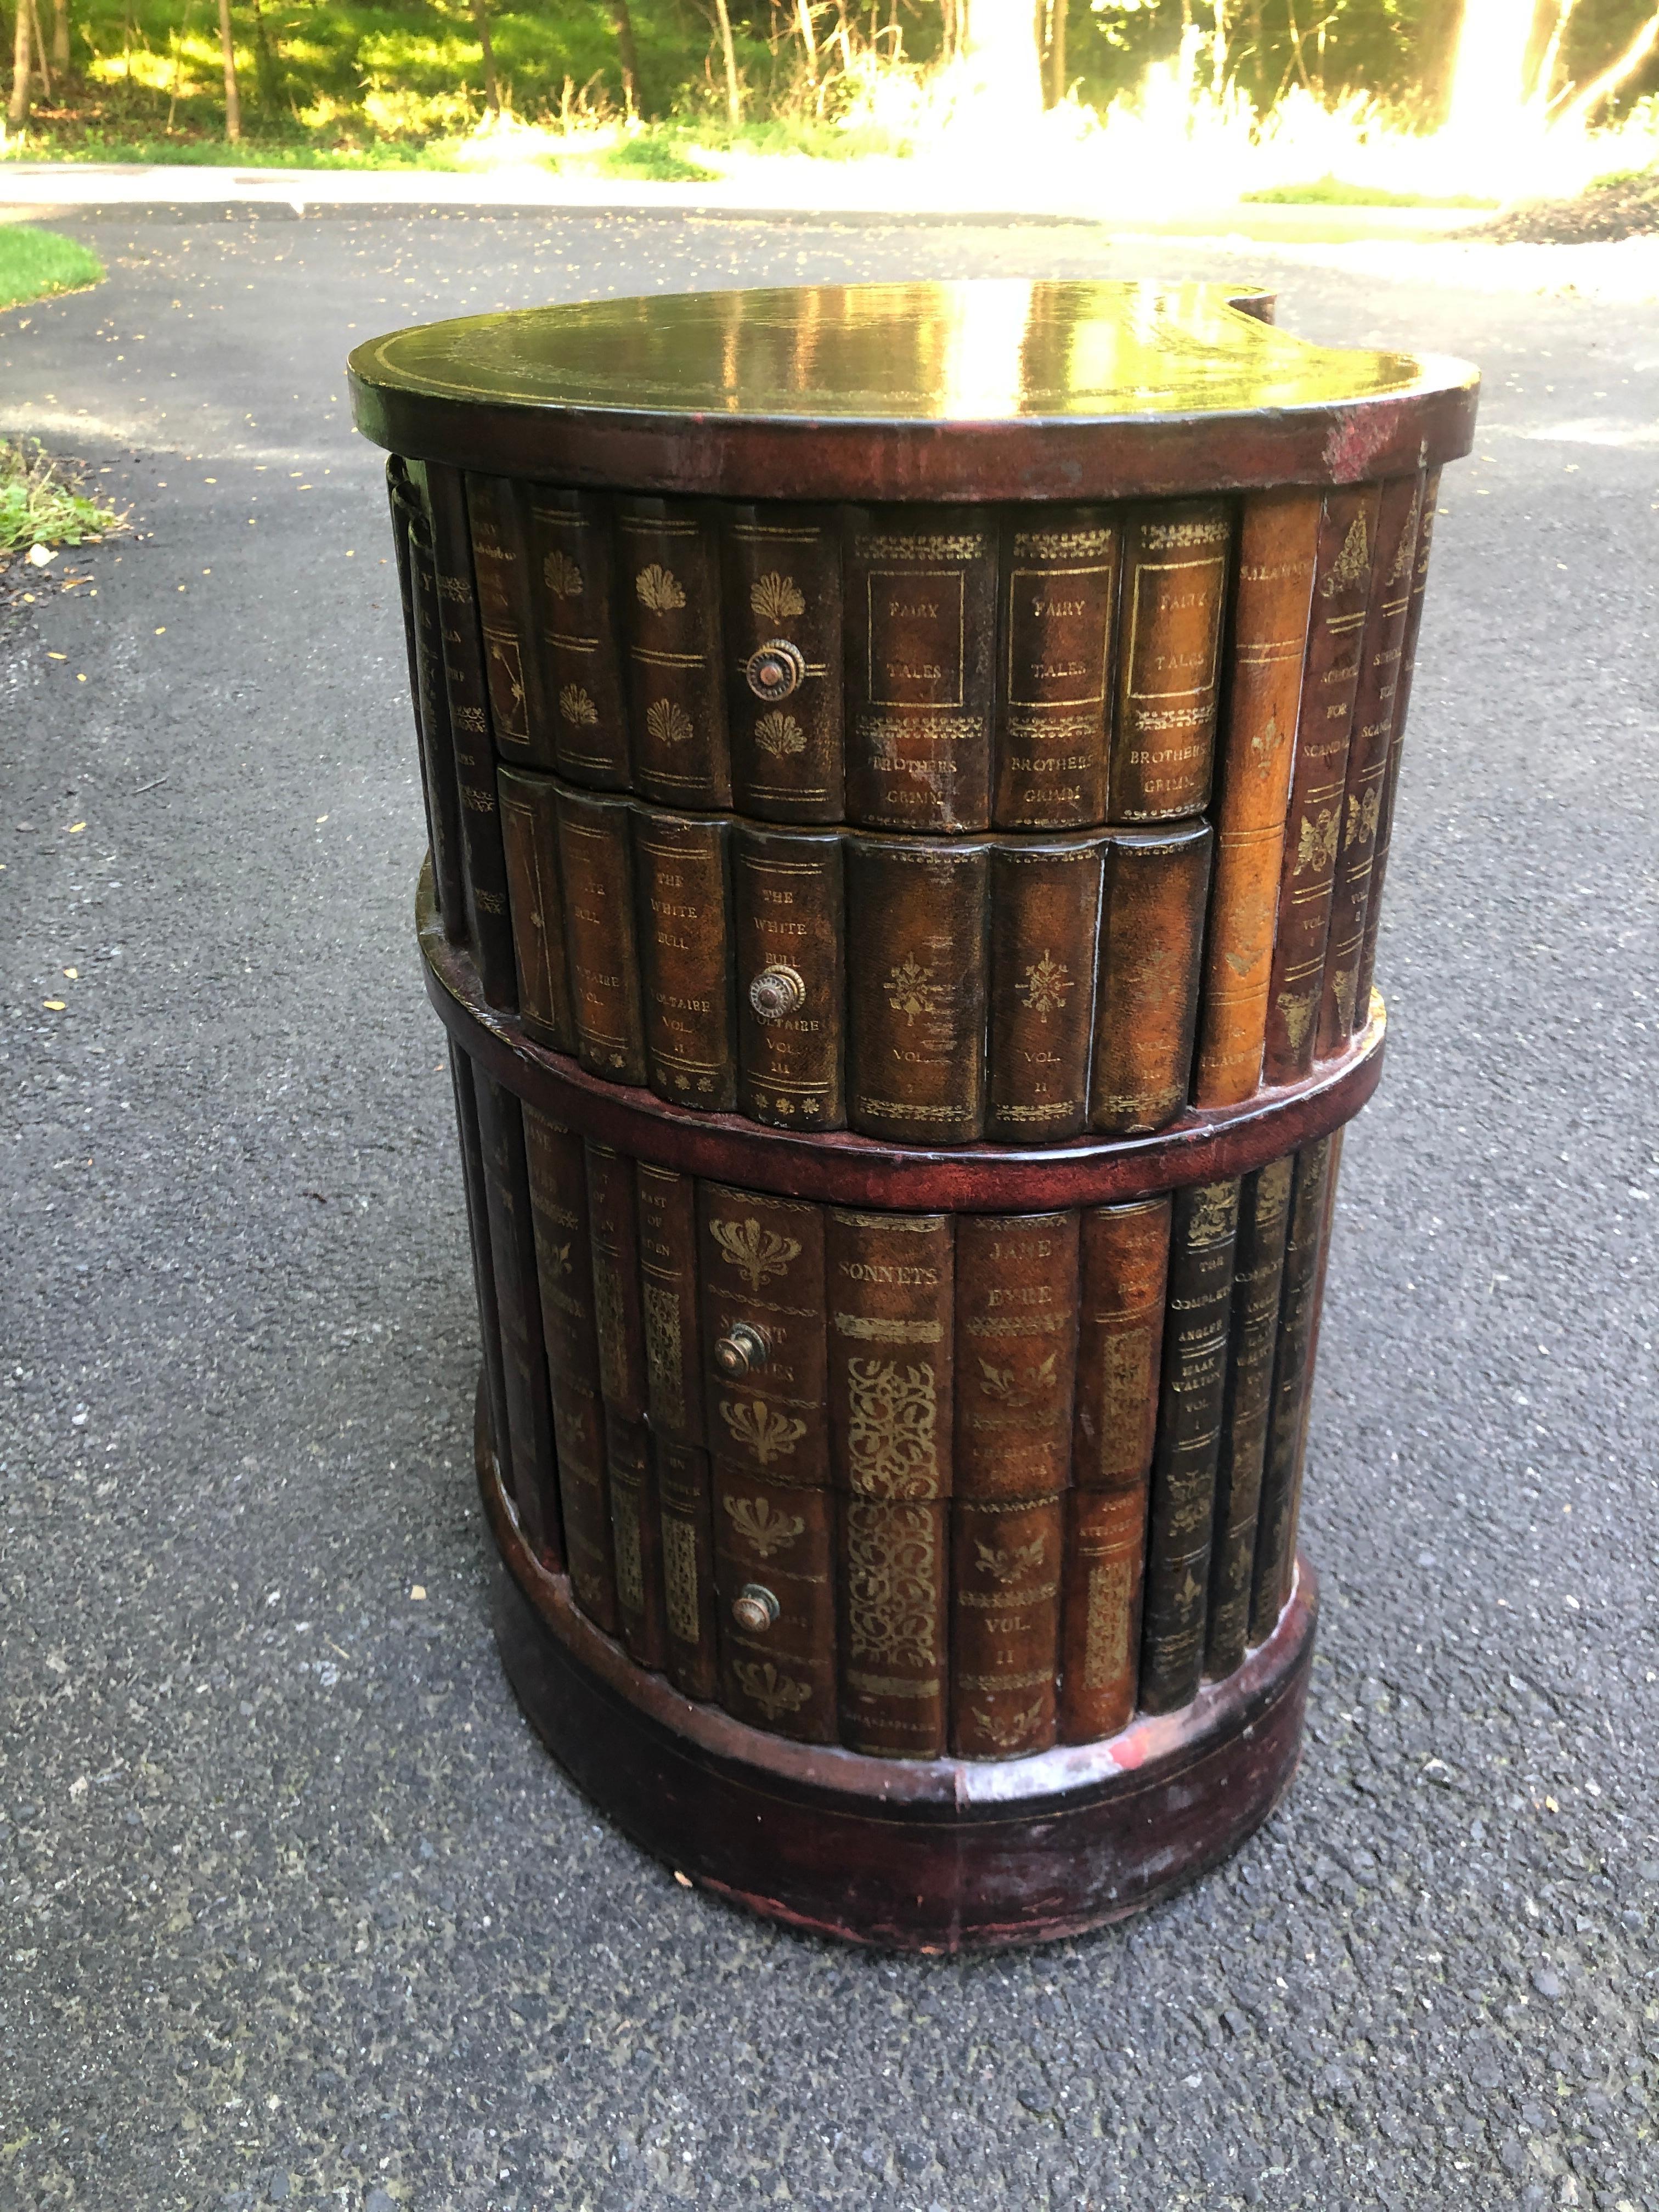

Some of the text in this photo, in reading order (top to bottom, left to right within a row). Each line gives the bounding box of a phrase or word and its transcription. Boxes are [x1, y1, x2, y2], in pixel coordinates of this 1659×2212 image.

[889, 601, 939, 619] FAIRY
[1031, 597, 1086, 617] FAIRY
[1160, 592, 1206, 610] FAIRY
[1031, 661, 1087, 678] TALES
[1155, 652, 1204, 670] TALES
[887, 662, 942, 679] TALES
[1327, 702, 1349, 720] FOR
[1011, 754, 1095, 771] BROTHERS
[1130, 743, 1206, 764] BROTHERS
[868, 755, 958, 773] BROTHERS
[658, 872, 684, 888] THE
[763, 889, 794, 904] THE
[650, 898, 698, 918] WHITE
[753, 917, 808, 935] WHITE
[658, 931, 690, 950] BULL
[765, 952, 801, 968] BULL
[989, 1239, 1052, 1260] JANE
[838, 1261, 939, 1285] SONNETS
[985, 1616, 1031, 1633] VOL.
[996, 1650, 1014, 1664] II
